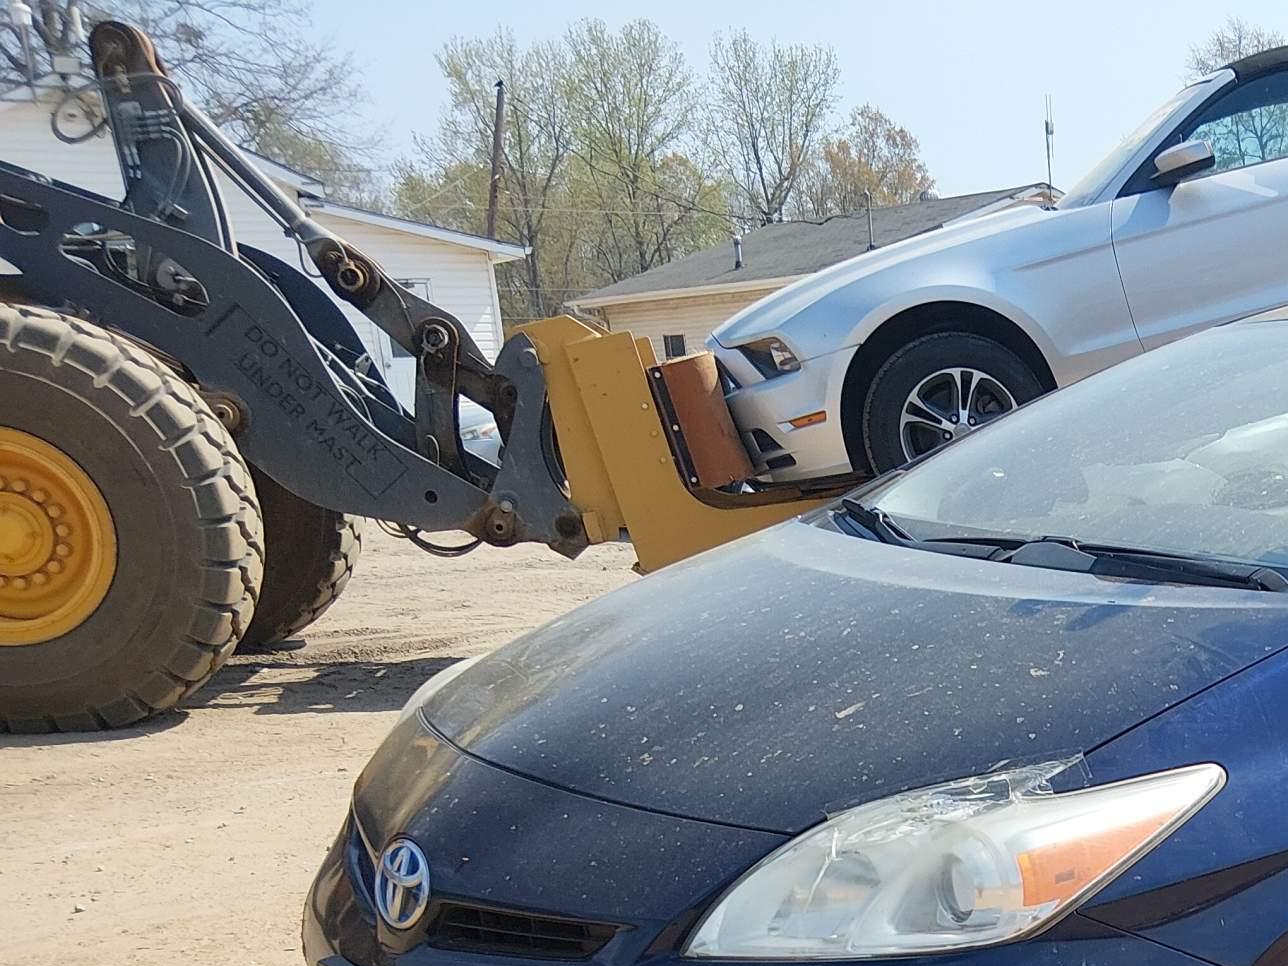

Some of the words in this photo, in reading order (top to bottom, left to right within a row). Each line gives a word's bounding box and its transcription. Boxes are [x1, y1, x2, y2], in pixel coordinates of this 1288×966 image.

[237, 352, 305, 418] UNDER
[306, 420, 363, 469] MAST
[244, 325, 279, 358] DO
[279, 358, 328, 403] NOT
[327, 402, 384, 461] WALK
